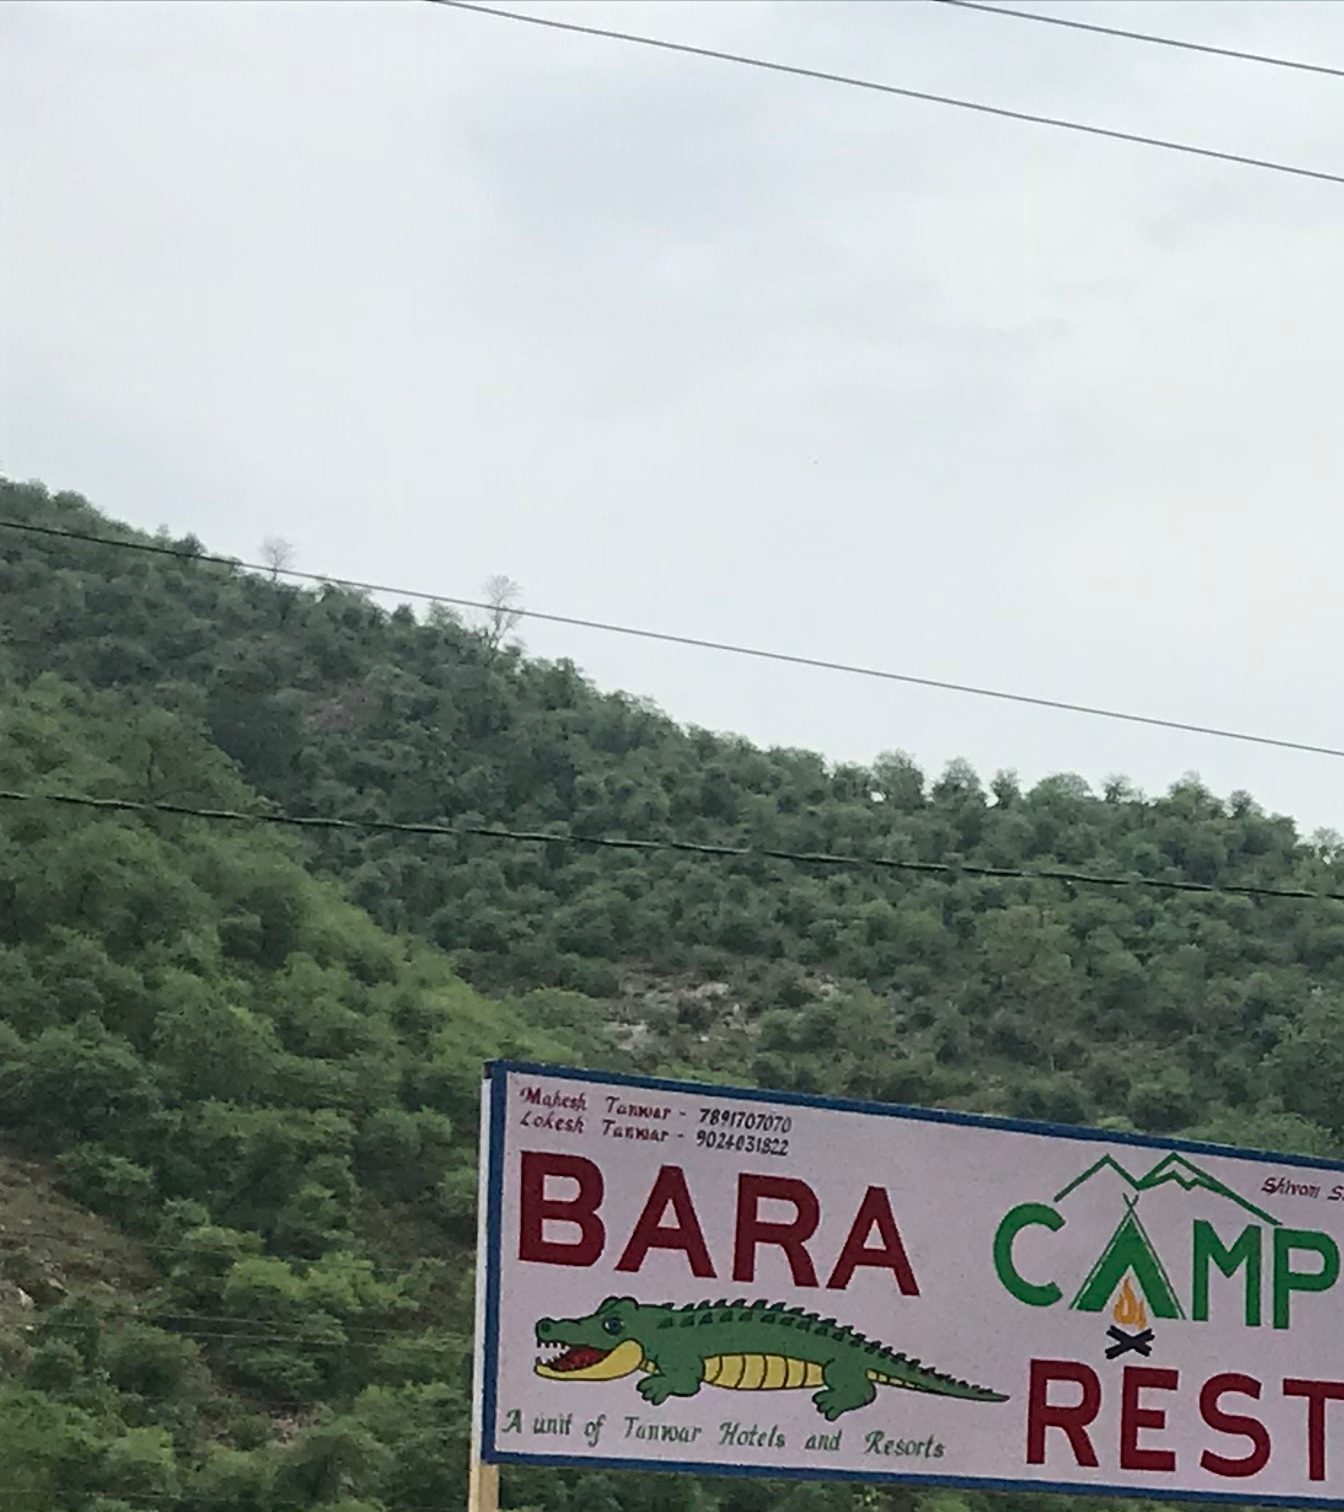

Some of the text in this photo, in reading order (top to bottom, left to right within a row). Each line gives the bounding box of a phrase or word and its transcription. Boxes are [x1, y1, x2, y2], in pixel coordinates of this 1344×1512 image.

[520, 1087, 587, 1111] Mahesh
[606, 1096, 671, 1120] Tanwar
[699, 1108, 792, 1134] 7891707070
[520, 1111, 585, 1134] Lokesh
[602, 1119, 669, 1142] Tanwar
[518, 1150, 921, 1297] BARA
[993, 1195, 1341, 1330] CAMP
[501, 1409, 946, 1459] A unit of Tanwar Hotels and Resorts
